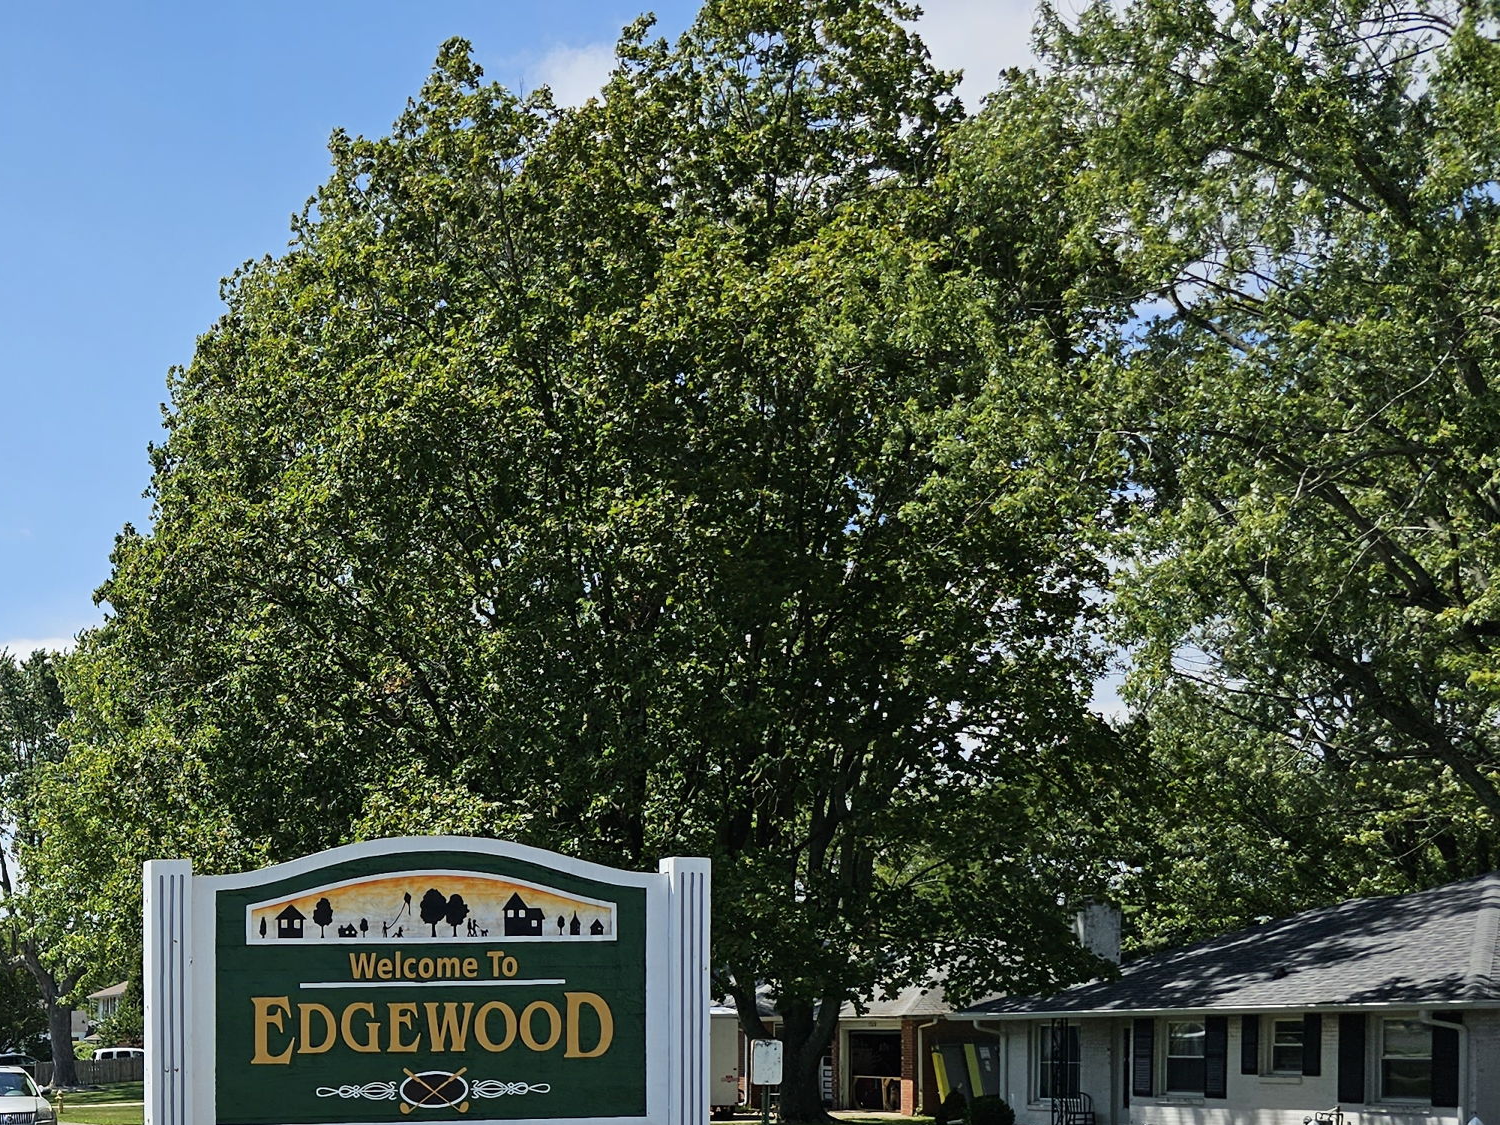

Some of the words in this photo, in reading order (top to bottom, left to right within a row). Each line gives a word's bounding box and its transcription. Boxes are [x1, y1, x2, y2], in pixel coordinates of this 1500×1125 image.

[349, 951, 478, 979] Welcome
[486, 950, 519, 978] To
[250, 991, 614, 1064] EDGEWOOD
